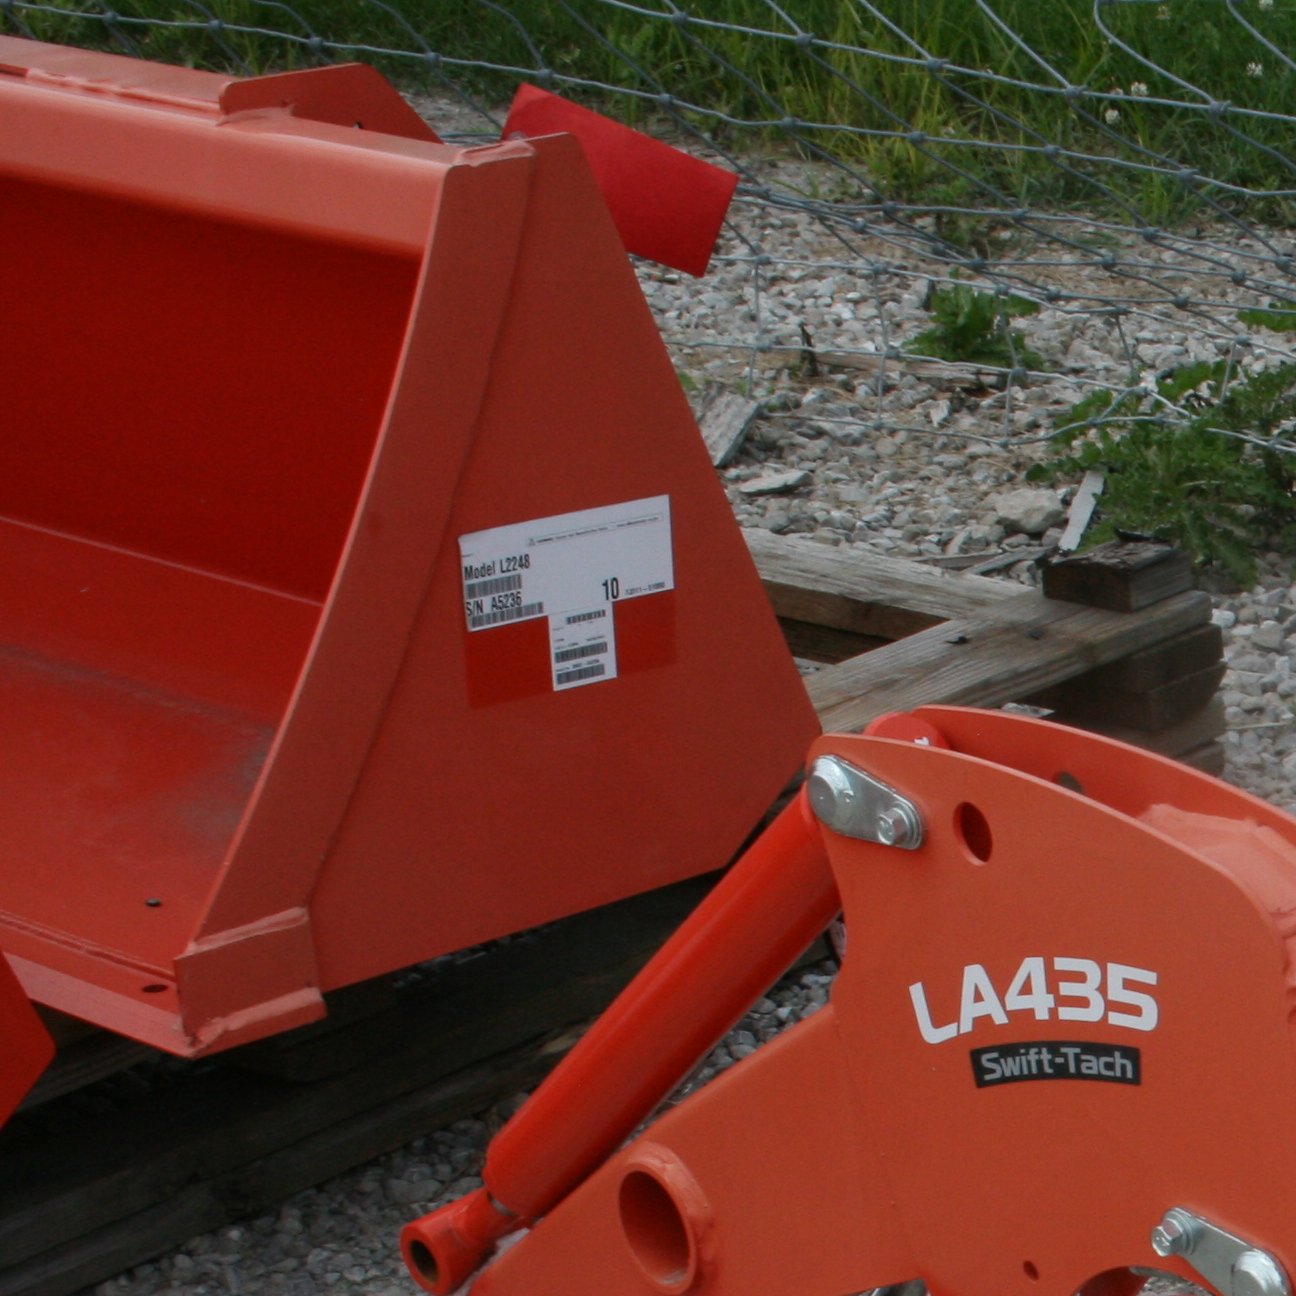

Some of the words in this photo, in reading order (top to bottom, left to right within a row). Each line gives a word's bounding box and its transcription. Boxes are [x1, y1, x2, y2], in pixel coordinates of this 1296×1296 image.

[464, 561, 496, 581] Model
[500, 554, 530, 574] L2248
[602, 577, 620, 601] 10
[465, 600, 484, 617] S/N
[909, 956, 1159, 1045] LA435
[980, 1046, 1134, 1082] Swift-Tach
